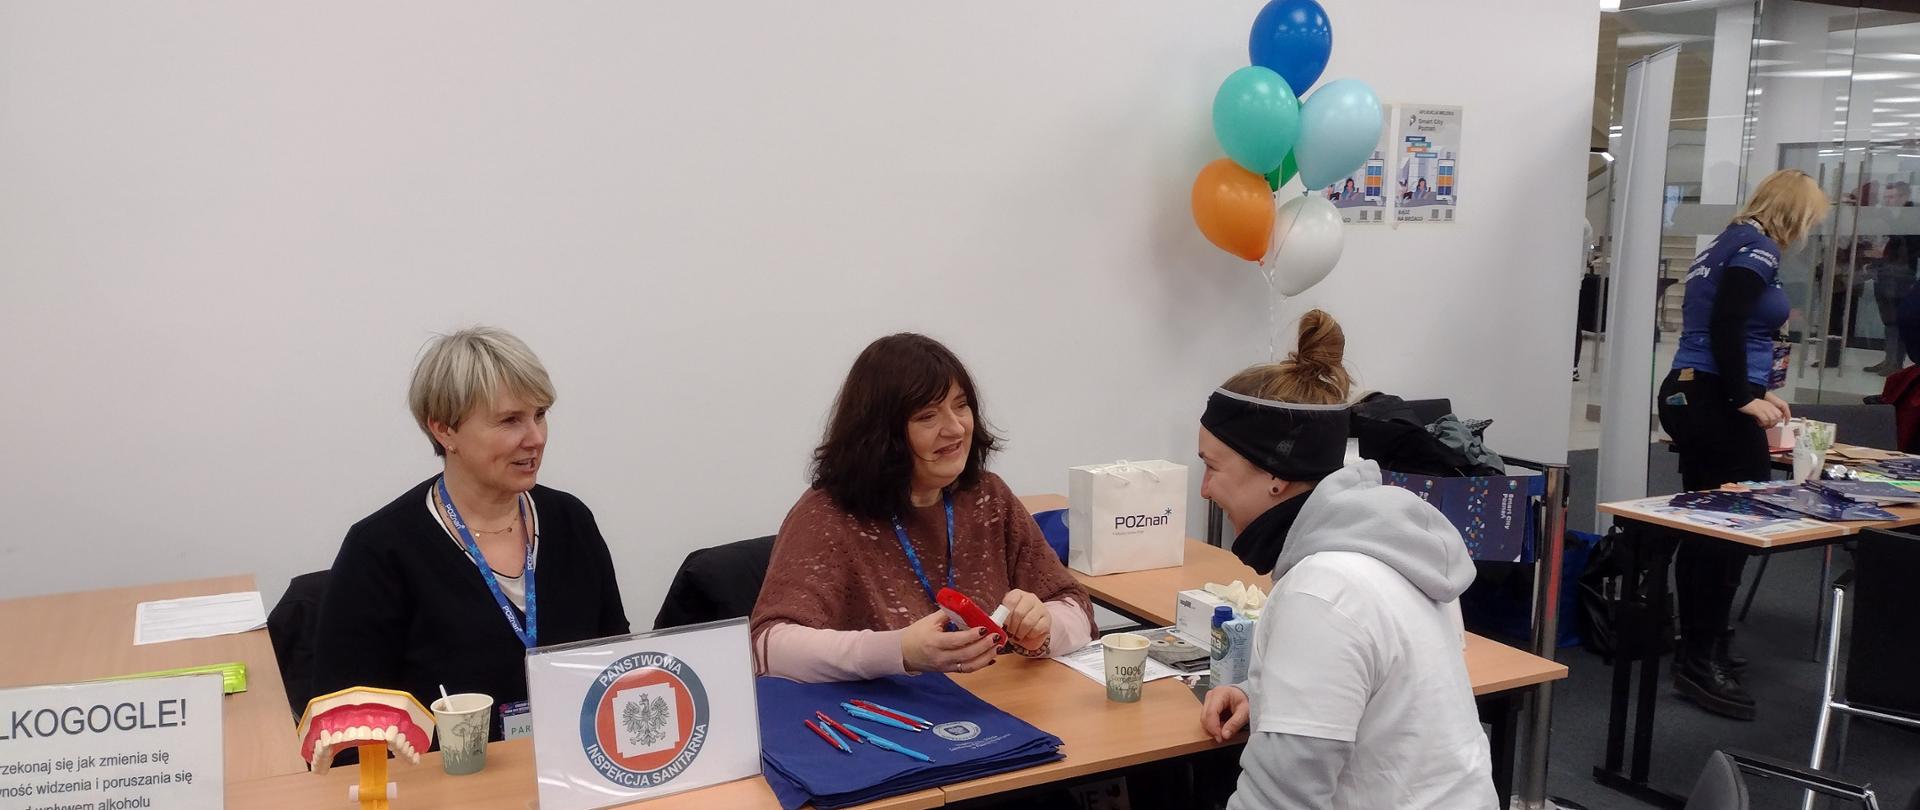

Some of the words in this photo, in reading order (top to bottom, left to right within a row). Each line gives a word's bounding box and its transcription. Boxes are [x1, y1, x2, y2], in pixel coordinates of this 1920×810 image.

[599, 655, 683, 688] PAŃSTWOWA
[0, 698, 187, 740] KOGOGLE!
[55, 757, 73, 773] się
[76, 756, 95, 772] jak
[99, 752, 147, 767] zmienia
[151, 750, 169, 764] się
[587, 743, 650, 786] INSPEKCJA
[652, 723, 707, 784] SANITARNA
[0, 784, 33, 797] ność
[36, 779, 91, 795] widzenia
[103, 771, 171, 792] poruszania
[175, 770, 192, 784] się
[98, 796, 150, 810] alkoholu
